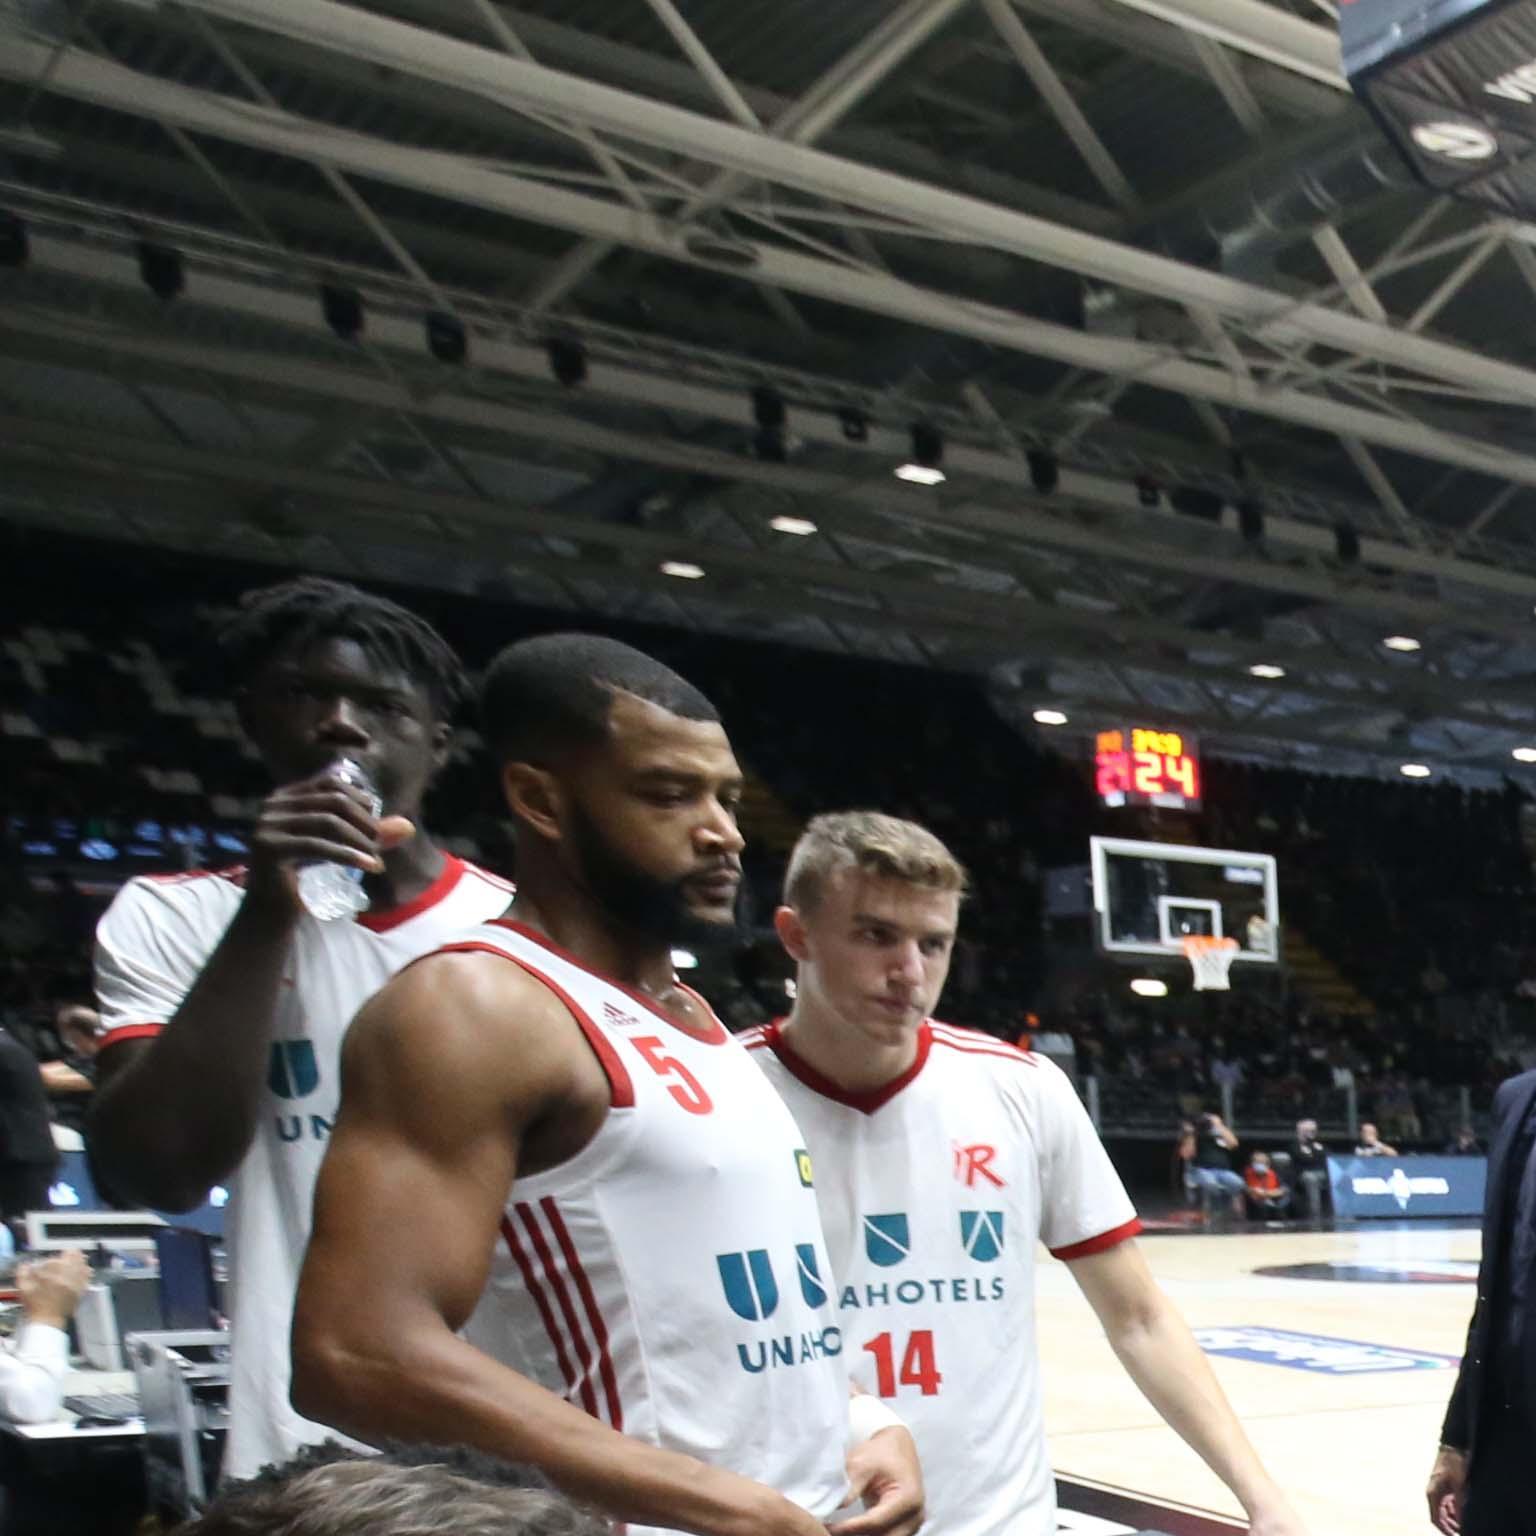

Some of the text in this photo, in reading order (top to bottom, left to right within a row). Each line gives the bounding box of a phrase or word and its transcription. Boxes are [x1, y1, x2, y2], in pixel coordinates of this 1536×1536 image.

[629, 1036, 714, 1115] 5
[839, 1276, 1005, 1310] AHOTELS
[863, 1329, 942, 1399] 14
